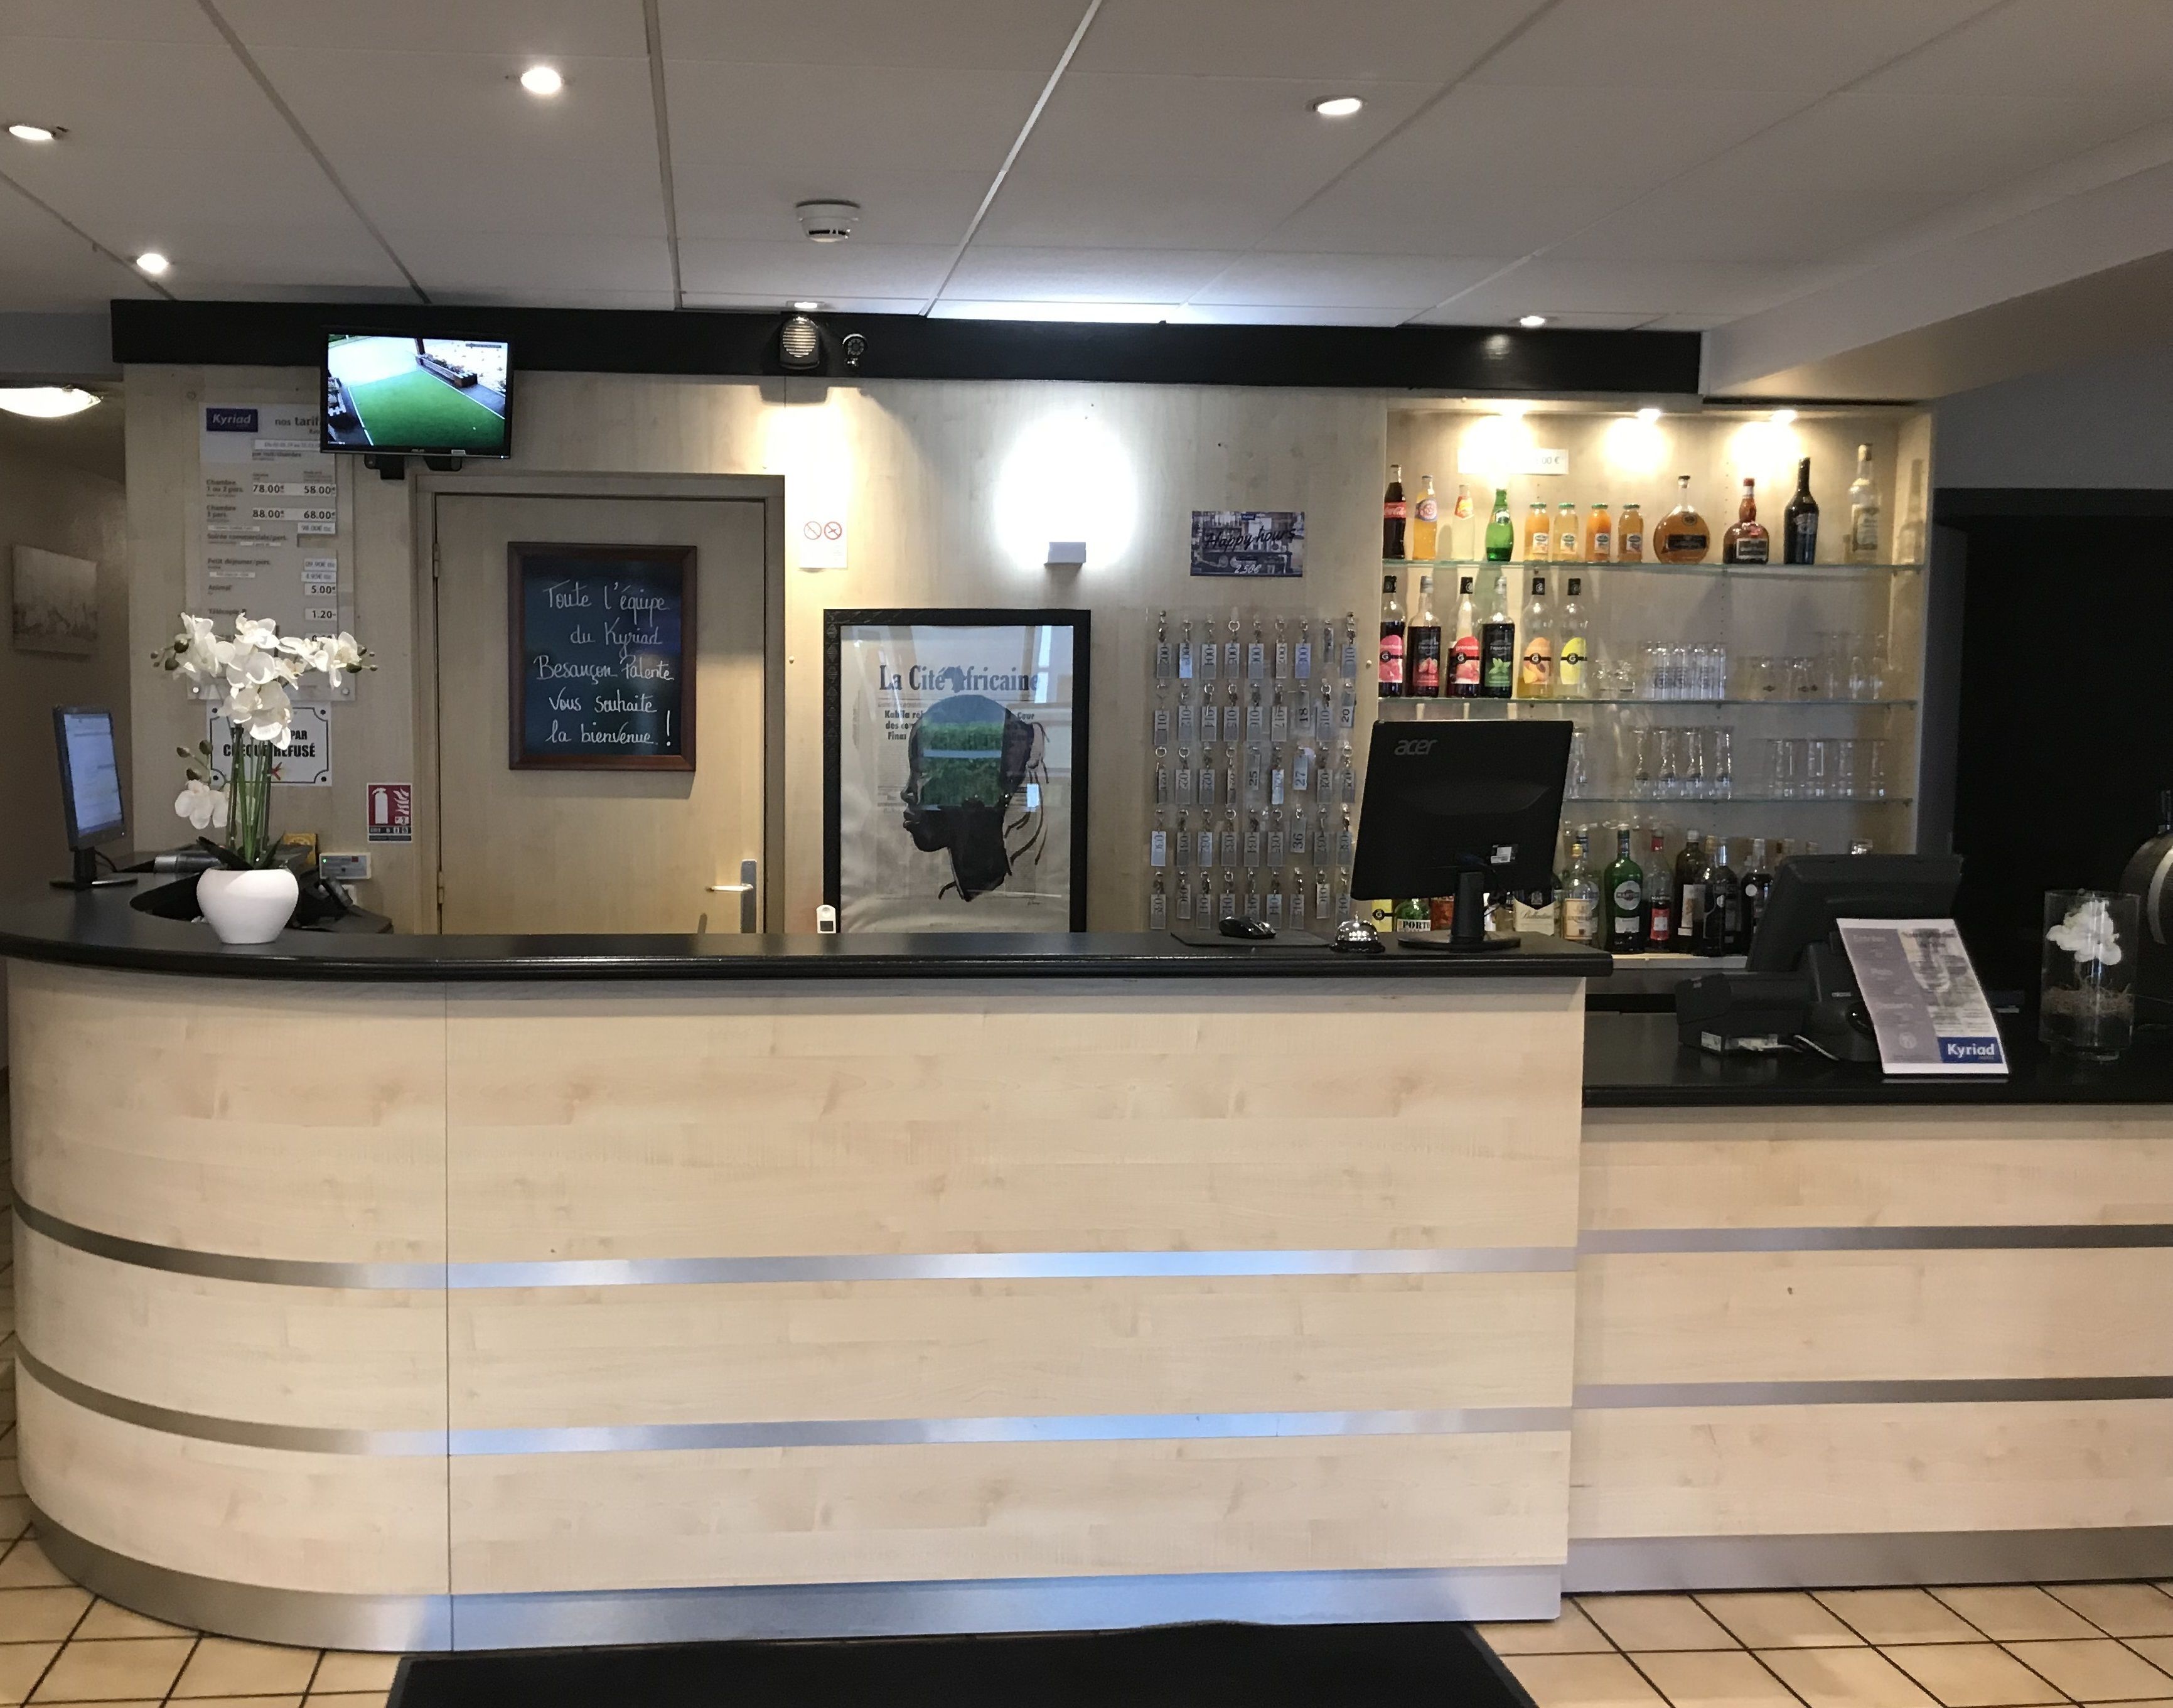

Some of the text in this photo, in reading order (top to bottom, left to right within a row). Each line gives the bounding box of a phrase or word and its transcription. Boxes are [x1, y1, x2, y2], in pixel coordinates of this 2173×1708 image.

[213, 414, 252, 426] Kyriad
[1205, 532, 1253, 552] Happy
[542, 579, 670, 627] Toute l'équipe
[570, 616, 662, 659] du Kyriad
[1205, 648, 1214, 665] 004
[534, 655, 675, 685] Besançon Palente
[879, 665, 902, 690] La
[909, 665, 945, 690] Cité
[1157, 714, 1167, 731] 011
[1299, 707, 1309, 722] 18
[1342, 709, 1351, 722] 20
[545, 719, 572, 743] la
[666, 709, 672, 746] !
[886, 721, 899, 729] des
[291, 730, 307, 740] PAR
[274, 743, 315, 758] REFUSÉ
[1394, 739, 1438, 756] acer
[1248, 770, 1258, 787] 25
[1295, 771, 1306, 786] 27
[1292, 833, 1304, 849] 36
[1947, 1043, 1995, 1058] Kyriad
